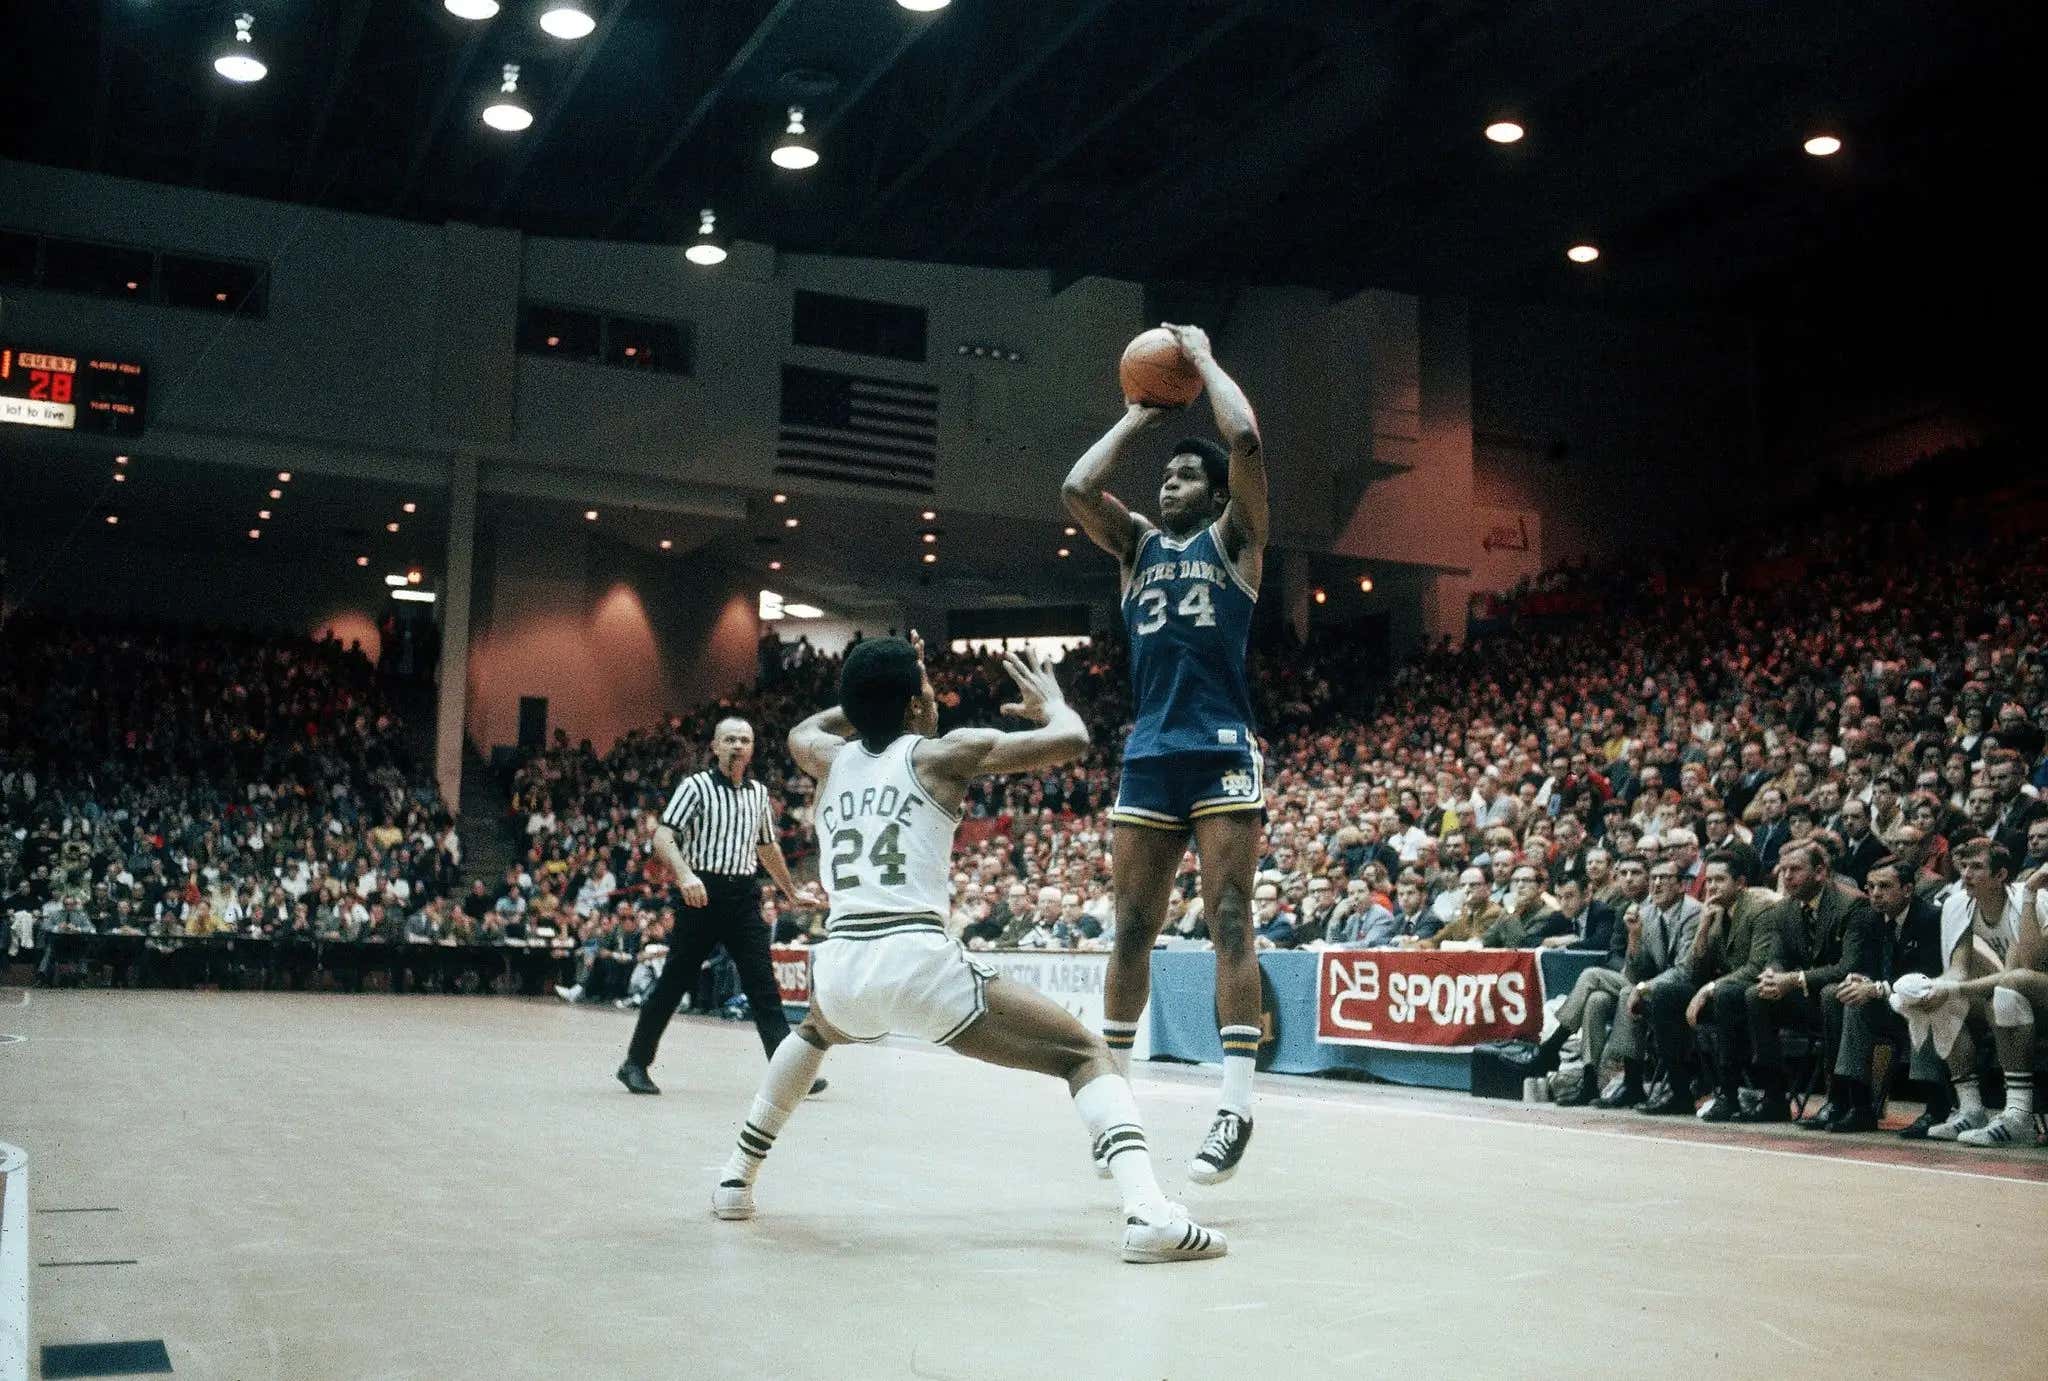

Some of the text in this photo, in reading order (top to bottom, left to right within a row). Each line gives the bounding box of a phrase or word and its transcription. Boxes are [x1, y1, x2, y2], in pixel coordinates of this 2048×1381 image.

[6, 404, 64, 420] lot to live
[30, 370, 72, 403] 28
[1137, 584, 1217, 635] 34
[832, 823, 907, 891] 24
[1330, 958, 1528, 1032] NBC SPORTS
